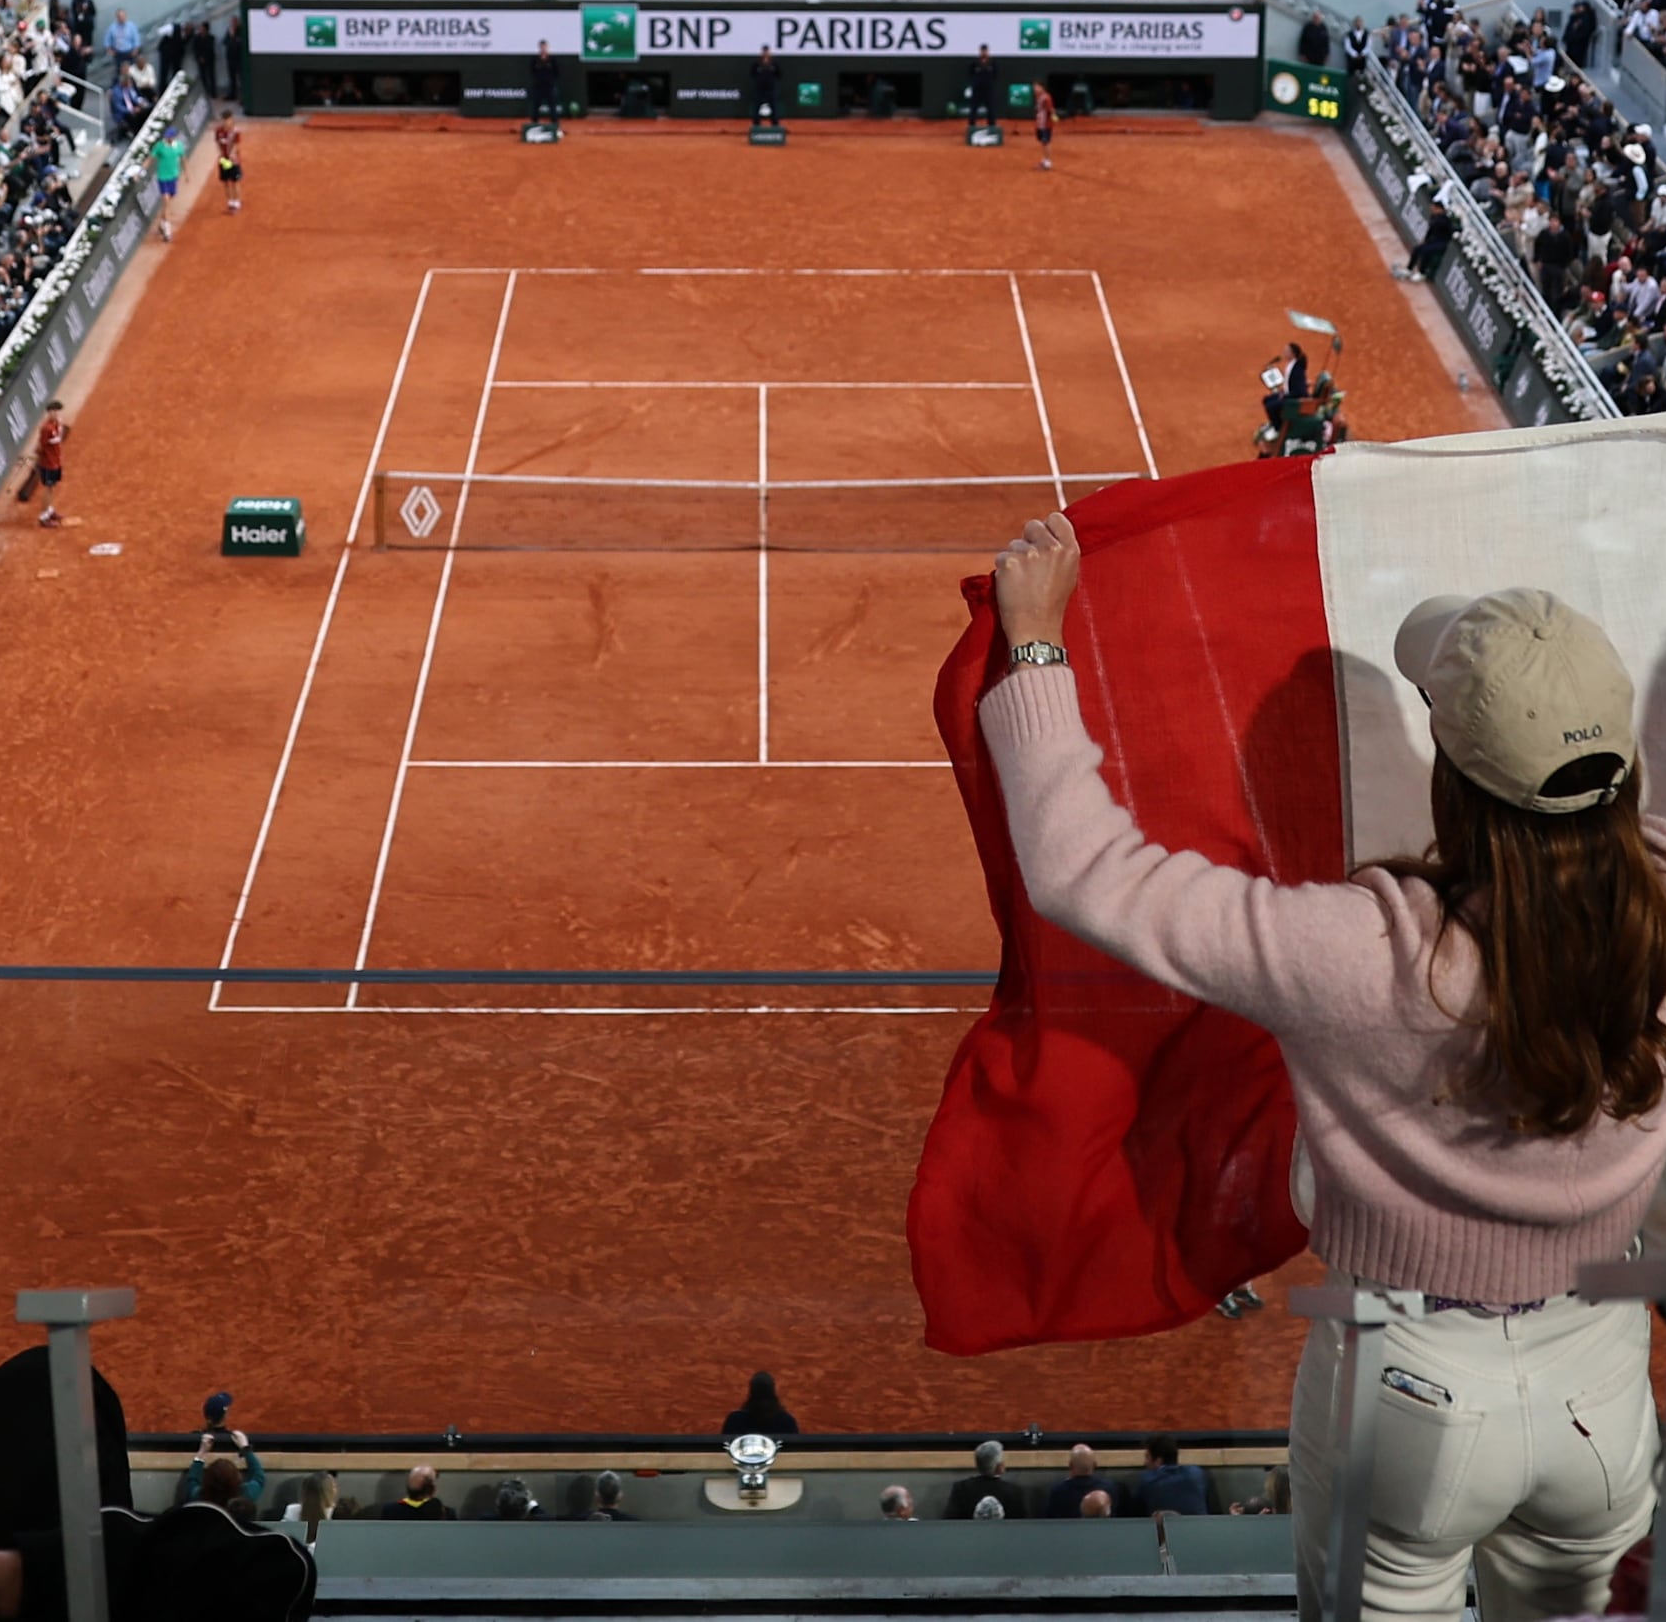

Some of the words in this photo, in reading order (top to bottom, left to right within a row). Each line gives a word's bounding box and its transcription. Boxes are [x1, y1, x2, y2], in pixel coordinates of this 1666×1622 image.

[345, 18, 390, 36] BNP
[397, 18, 491, 36] PARIBAS
[648, 18, 731, 49] BNP
[775, 18, 947, 50] PARIBAS
[1059, 21, 1104, 38] BNP
[1111, 21, 1203, 40] PARIBAS
[231, 525, 288, 543] Haier
[1563, 724, 1602, 745] POLO
